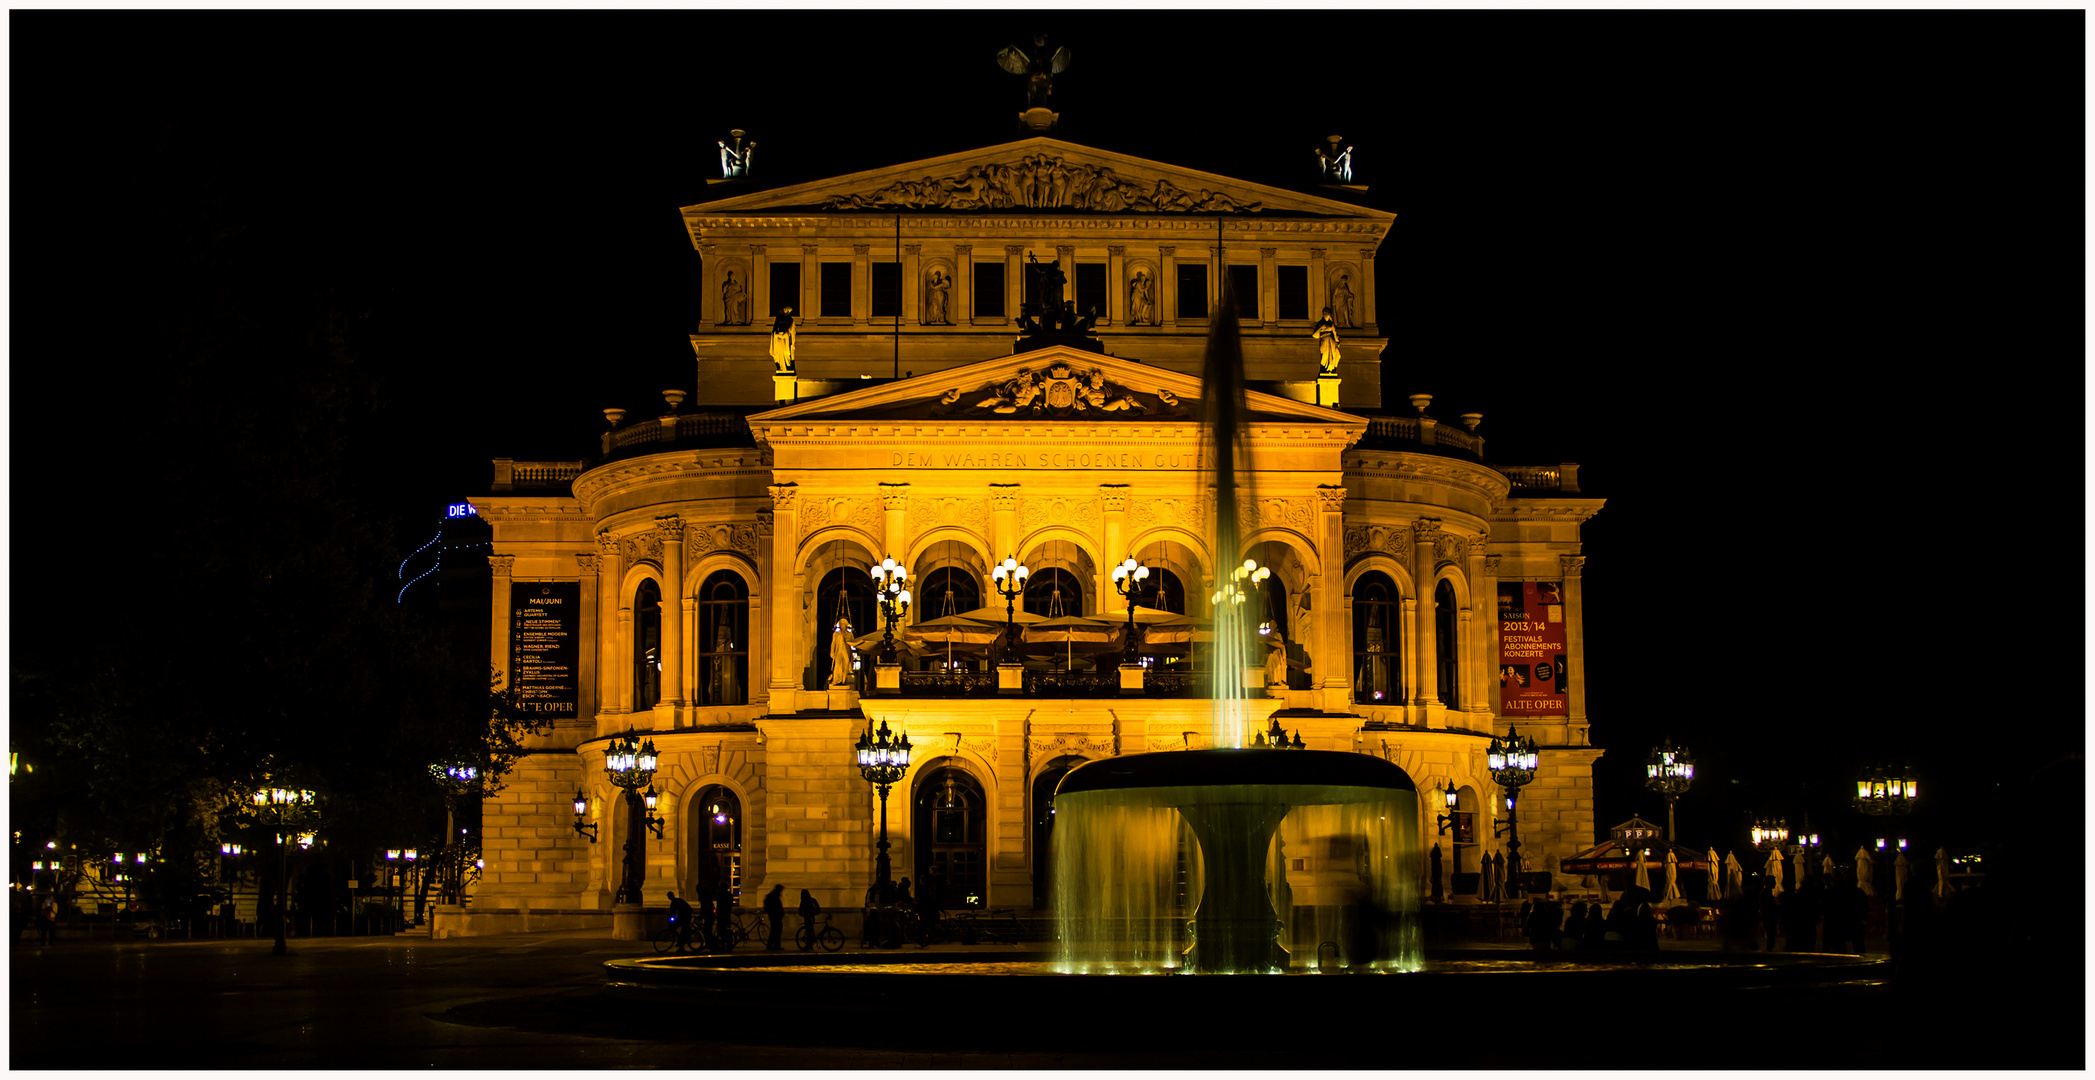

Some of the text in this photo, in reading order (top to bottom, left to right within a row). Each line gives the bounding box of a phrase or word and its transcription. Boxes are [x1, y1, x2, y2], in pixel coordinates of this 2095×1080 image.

[892, 452, 932, 467] DEM
[944, 452, 1007, 467] WAHREN
[1039, 453, 1142, 467] SCHOENEN
[449, 504, 466, 517] DIE
[529, 598, 563, 606] MAI/JUNI
[1503, 612, 1531, 620] SAISON
[1503, 621, 1546, 632] 2013/14
[1503, 635, 1543, 643] FESTIVALS
[1504, 650, 1544, 658] KONZERTE
[544, 702, 573, 712] OPER
[1505, 700, 1563, 710] ALTE OPER
